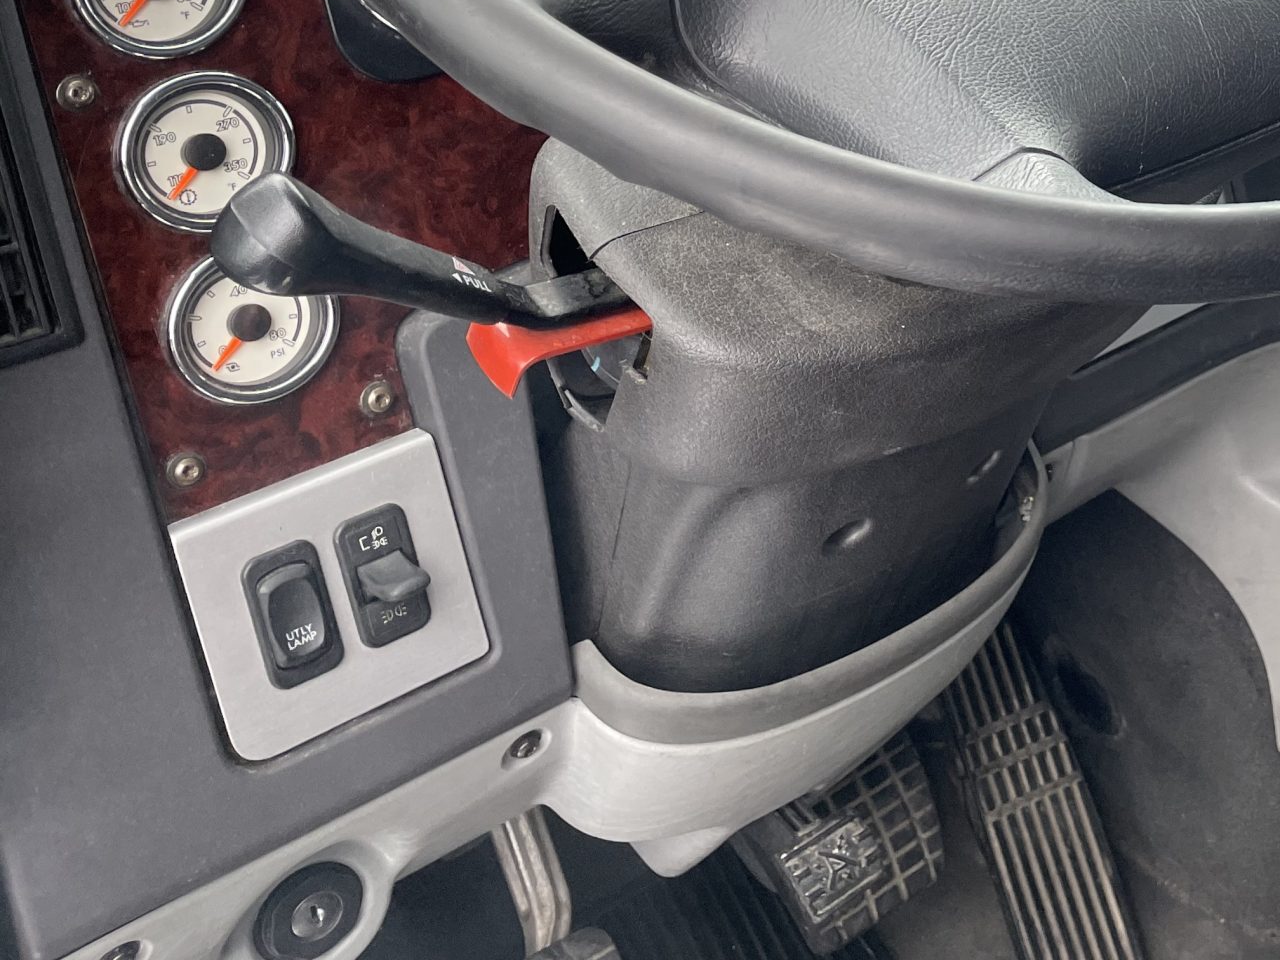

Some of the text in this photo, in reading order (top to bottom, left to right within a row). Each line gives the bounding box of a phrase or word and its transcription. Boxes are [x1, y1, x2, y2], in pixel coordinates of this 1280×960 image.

[216, 117, 240, 132] 270
[153, 132, 177, 147] 190
[223, 158, 248, 173] 350
[167, 173, 184, 187] 11
[462, 274, 493, 293] PULL
[269, 327, 287, 341] 80
[271, 347, 286, 359] PSI
[286, 623, 312, 641] UTLY
[288, 631, 317, 651] LAMP
